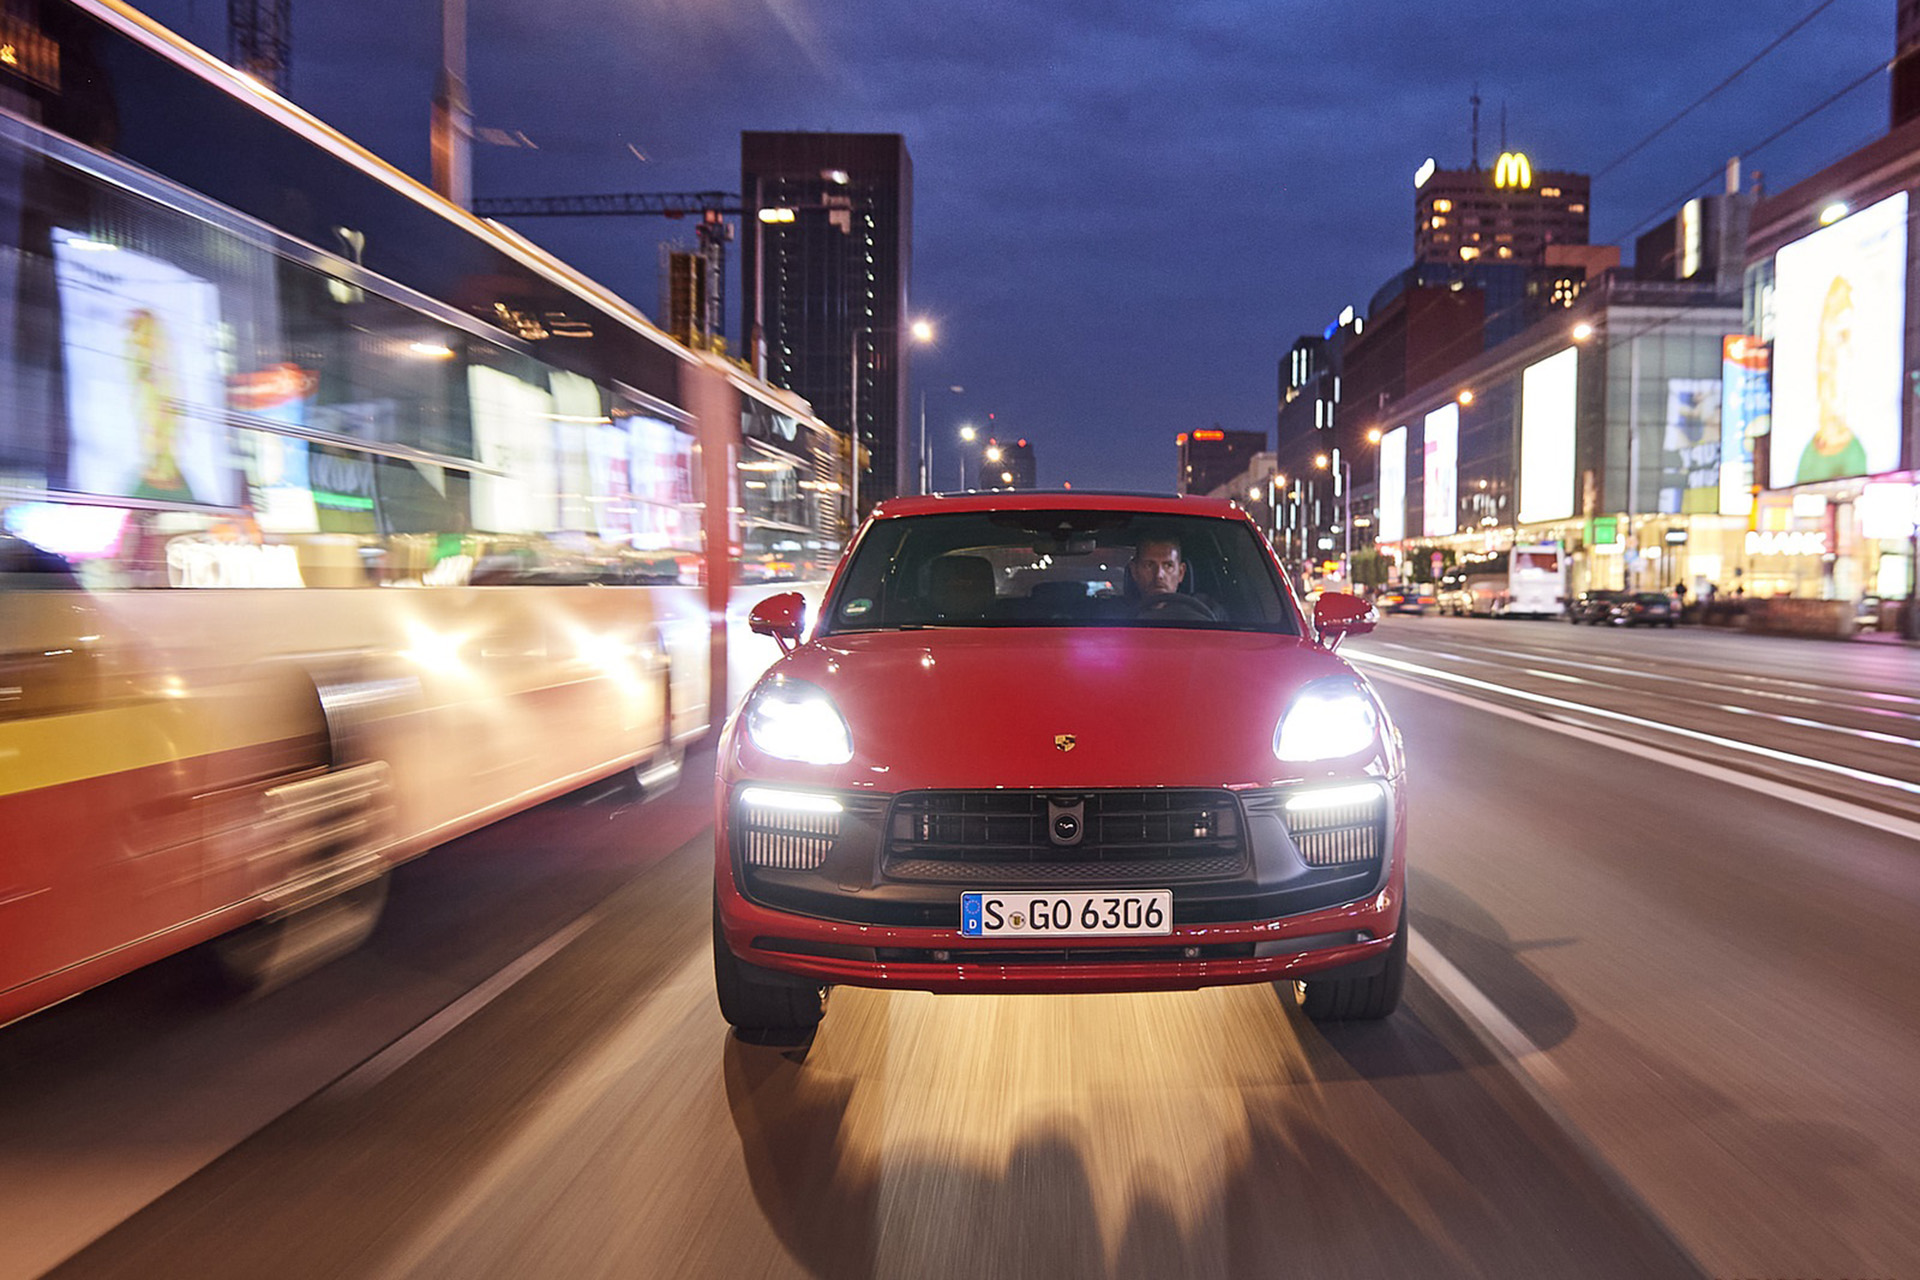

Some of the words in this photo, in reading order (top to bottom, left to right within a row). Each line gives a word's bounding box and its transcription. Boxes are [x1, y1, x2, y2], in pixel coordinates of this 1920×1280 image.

[968, 919, 978, 930] D
[984, 900, 1005, 930] S
[1029, 899, 1072, 930] GO
[1081, 898, 1164, 930] 6306
